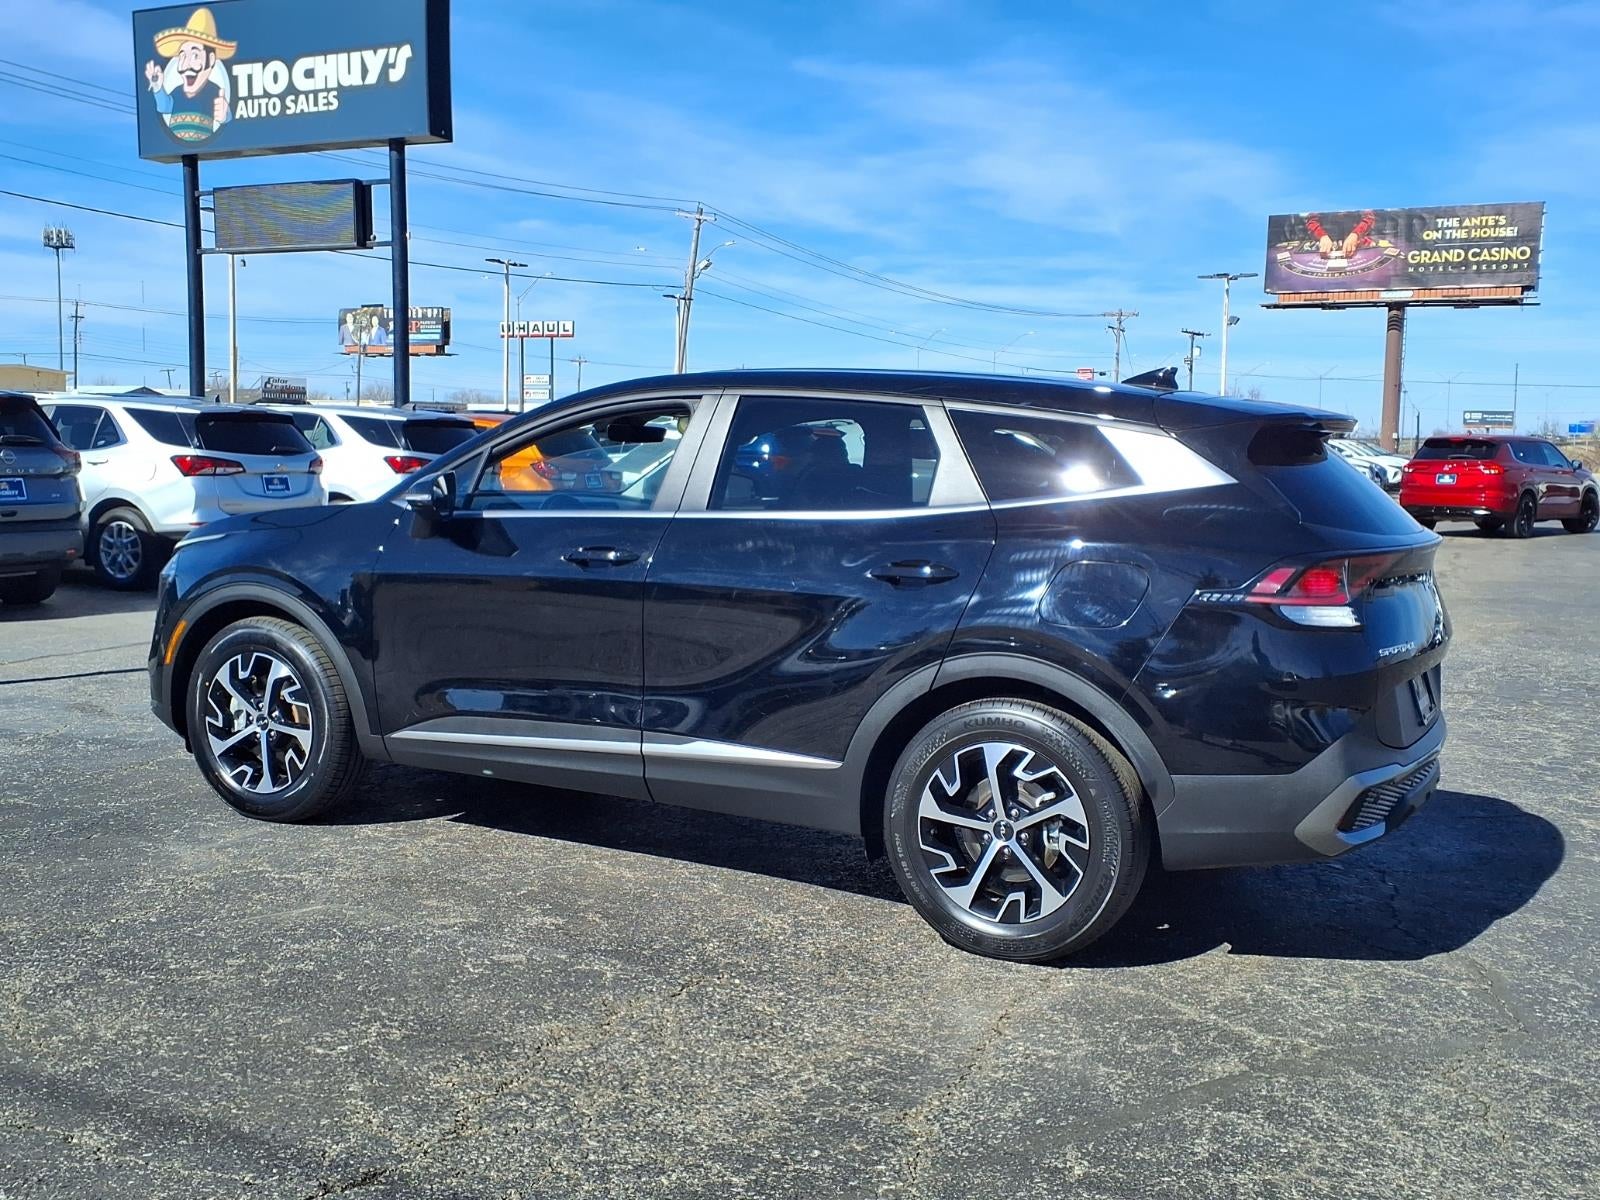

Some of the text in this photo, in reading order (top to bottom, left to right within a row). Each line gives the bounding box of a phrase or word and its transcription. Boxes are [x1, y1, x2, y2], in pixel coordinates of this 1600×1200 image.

[232, 44, 412, 98] TIO CHUY'S
[235, 91, 338, 119] AUTO SALES
[1436, 215, 1507, 228] THE ANTE'S
[1423, 227, 1518, 240] ON THE HOUSE!
[1407, 246, 1531, 264] GRAND CASINO
[1472, 263, 1529, 271] RESORT
[963, 716, 1026, 730] KUMHO
